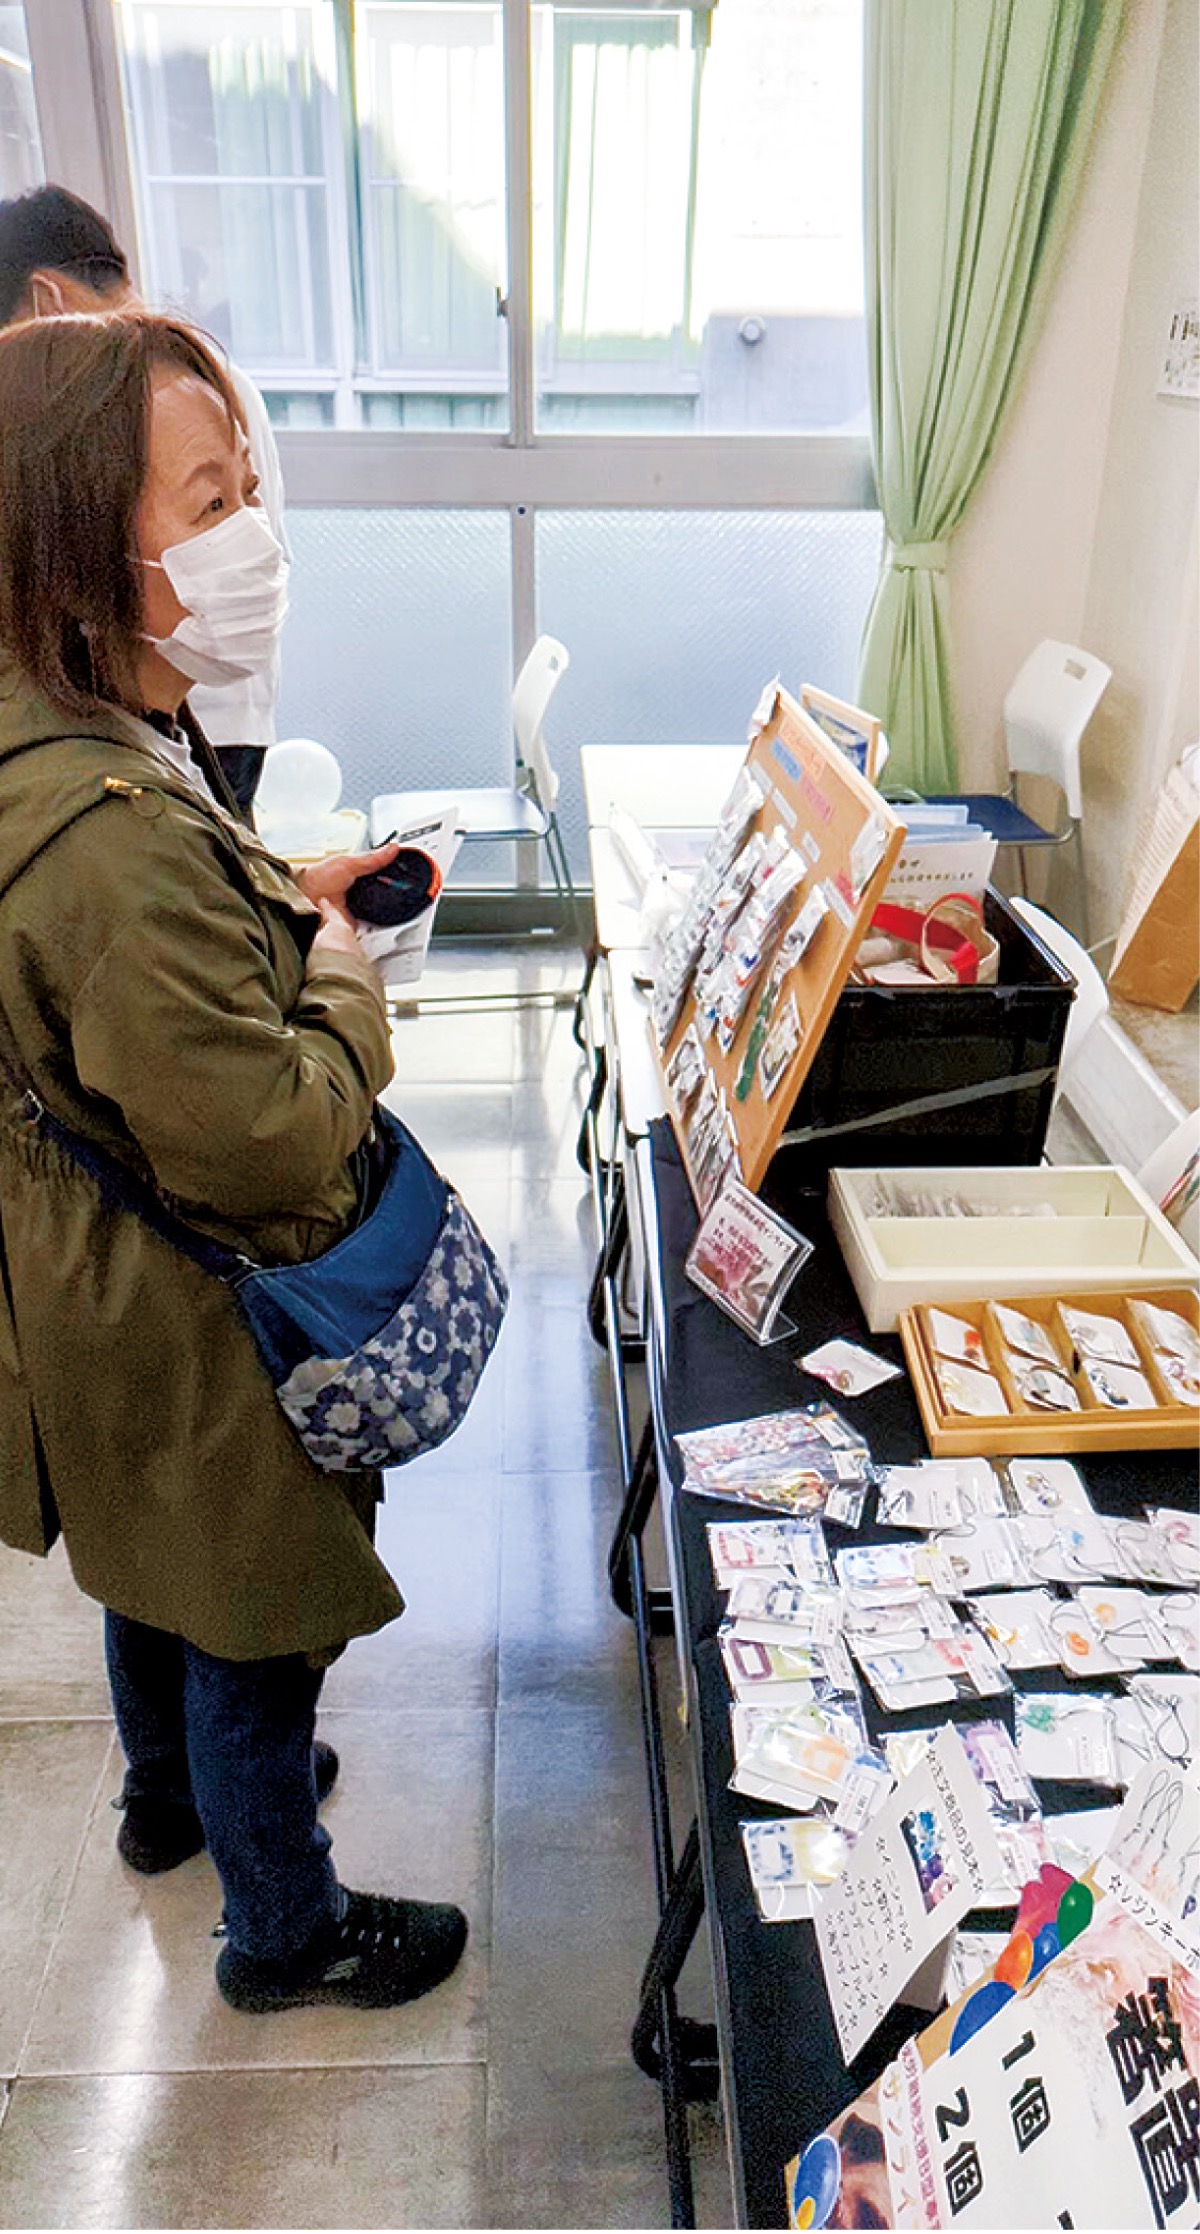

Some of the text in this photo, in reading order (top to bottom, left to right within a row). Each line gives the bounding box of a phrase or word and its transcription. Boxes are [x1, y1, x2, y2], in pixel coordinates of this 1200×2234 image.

[882, 2069, 920, 2231] サンライ
[935, 2087, 984, 2217] 2個
[1001, 2030, 1051, 2155] 1個
